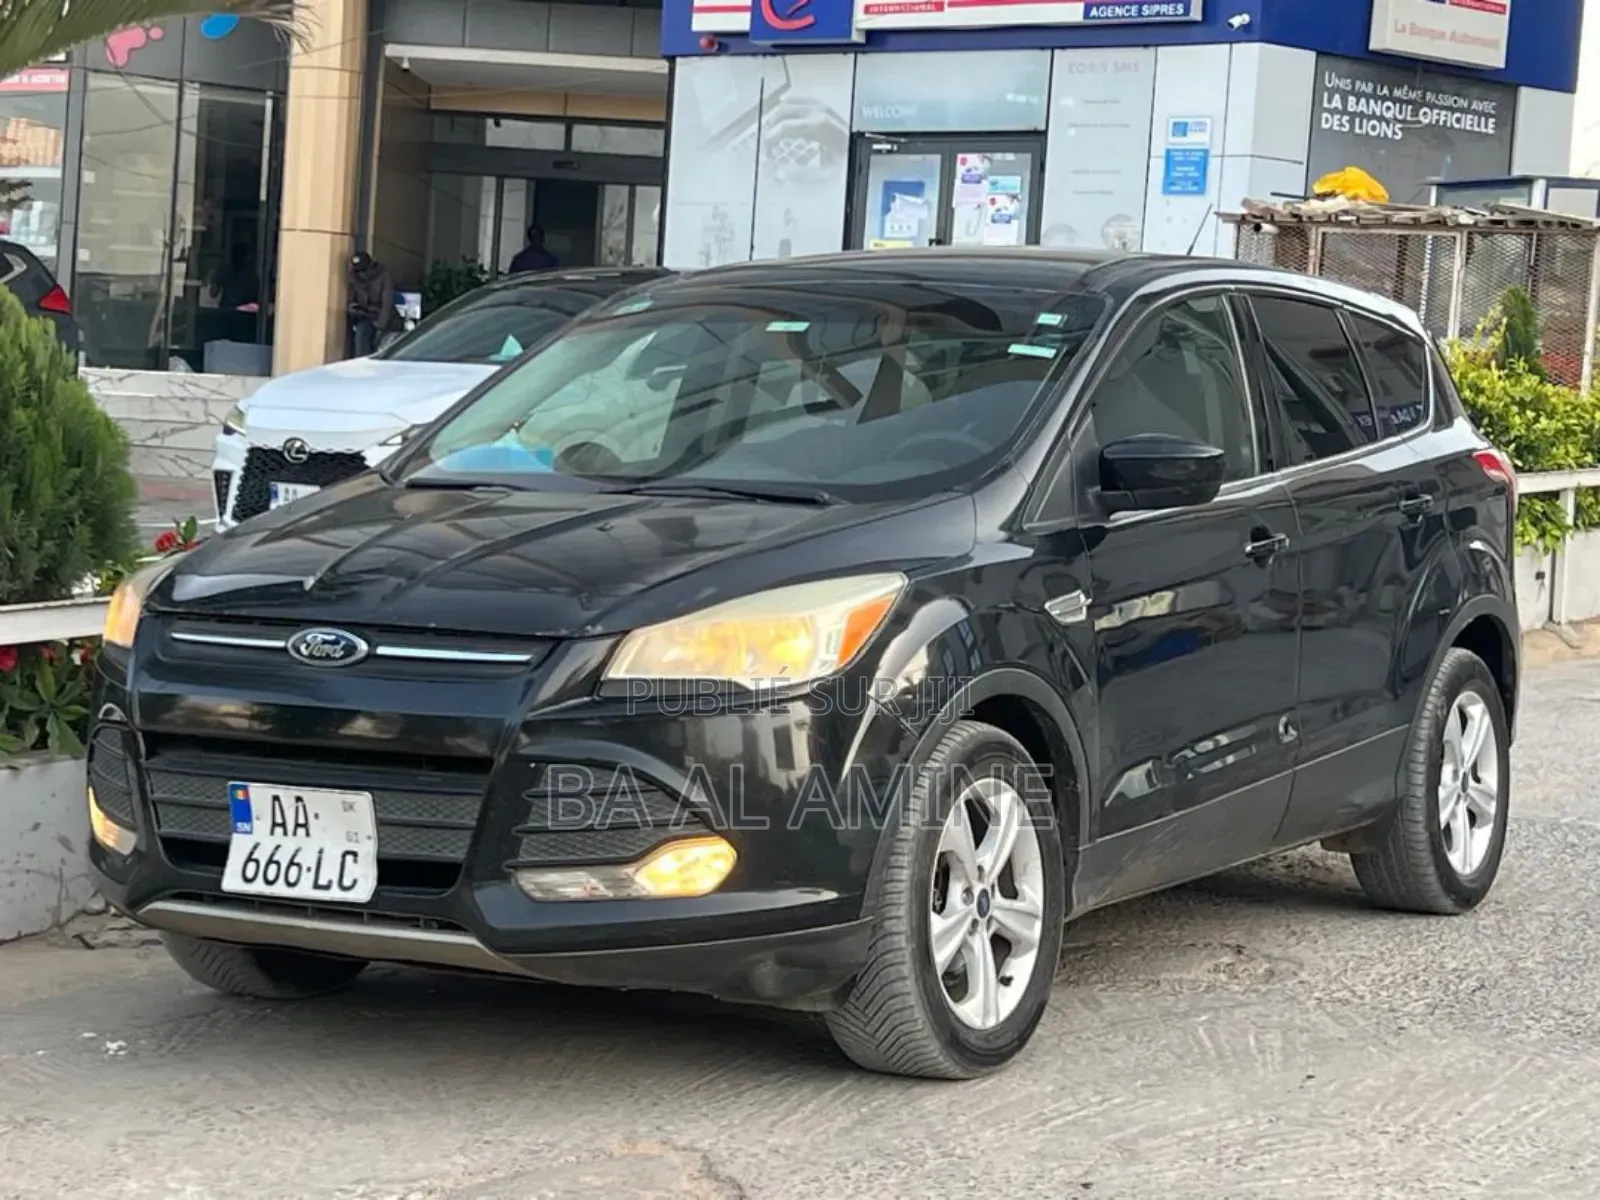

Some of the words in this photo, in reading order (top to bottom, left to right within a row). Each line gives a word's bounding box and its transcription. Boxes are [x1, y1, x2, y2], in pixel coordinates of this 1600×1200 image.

[1089, 5, 1139, 18] AGENCE
[1141, 3, 1185, 17] SIPRES
[1355, 80, 1374, 94] PAR
[1377, 85, 1389, 97] LA
[1392, 84, 1423, 101] MÊME
[1426, 91, 1468, 109] PASSION
[1471, 101, 1497, 115] AVEC
[1321, 112, 1350, 132] DES
[1355, 115, 1403, 140] LIONS
[1322, 92, 1342, 110] LA
[1347, 95, 1412, 121] BANQUE
[1419, 107, 1496, 134] OFFICIELLE
[300, 633, 345, 658] Ford
[236, 821, 251, 832] SN
